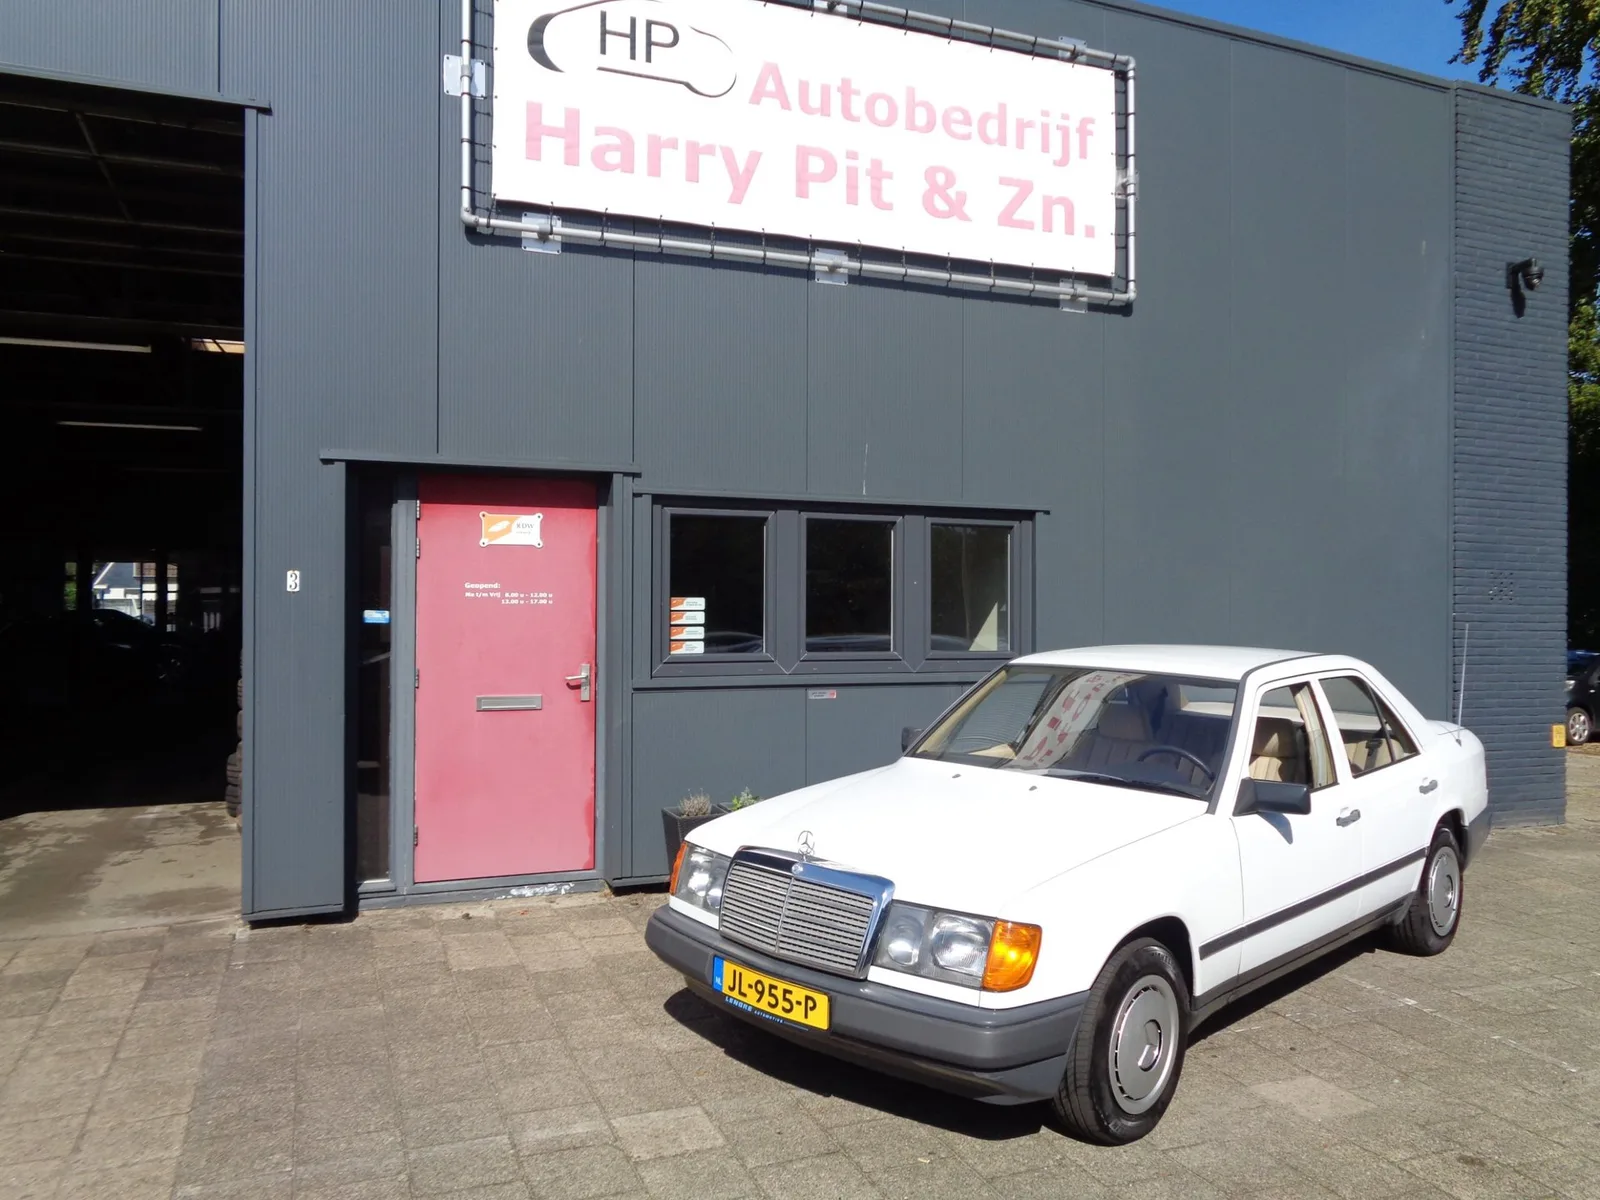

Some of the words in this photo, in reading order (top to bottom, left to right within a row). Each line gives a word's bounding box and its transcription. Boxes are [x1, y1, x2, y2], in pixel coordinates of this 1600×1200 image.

[599, 10, 680, 63] HP
[748, 61, 1096, 167] Autobedrijf
[524, 101, 762, 205] Harry
[794, 144, 894, 211] Pit
[922, 165, 973, 222] &
[997, 176, 1096, 238] Zn.
[289, 572, 298, 590] 3
[464, 582, 501, 590] Geopend:
[715, 976, 722, 986] NL
[728, 969, 817, 1019] JL-955-P
